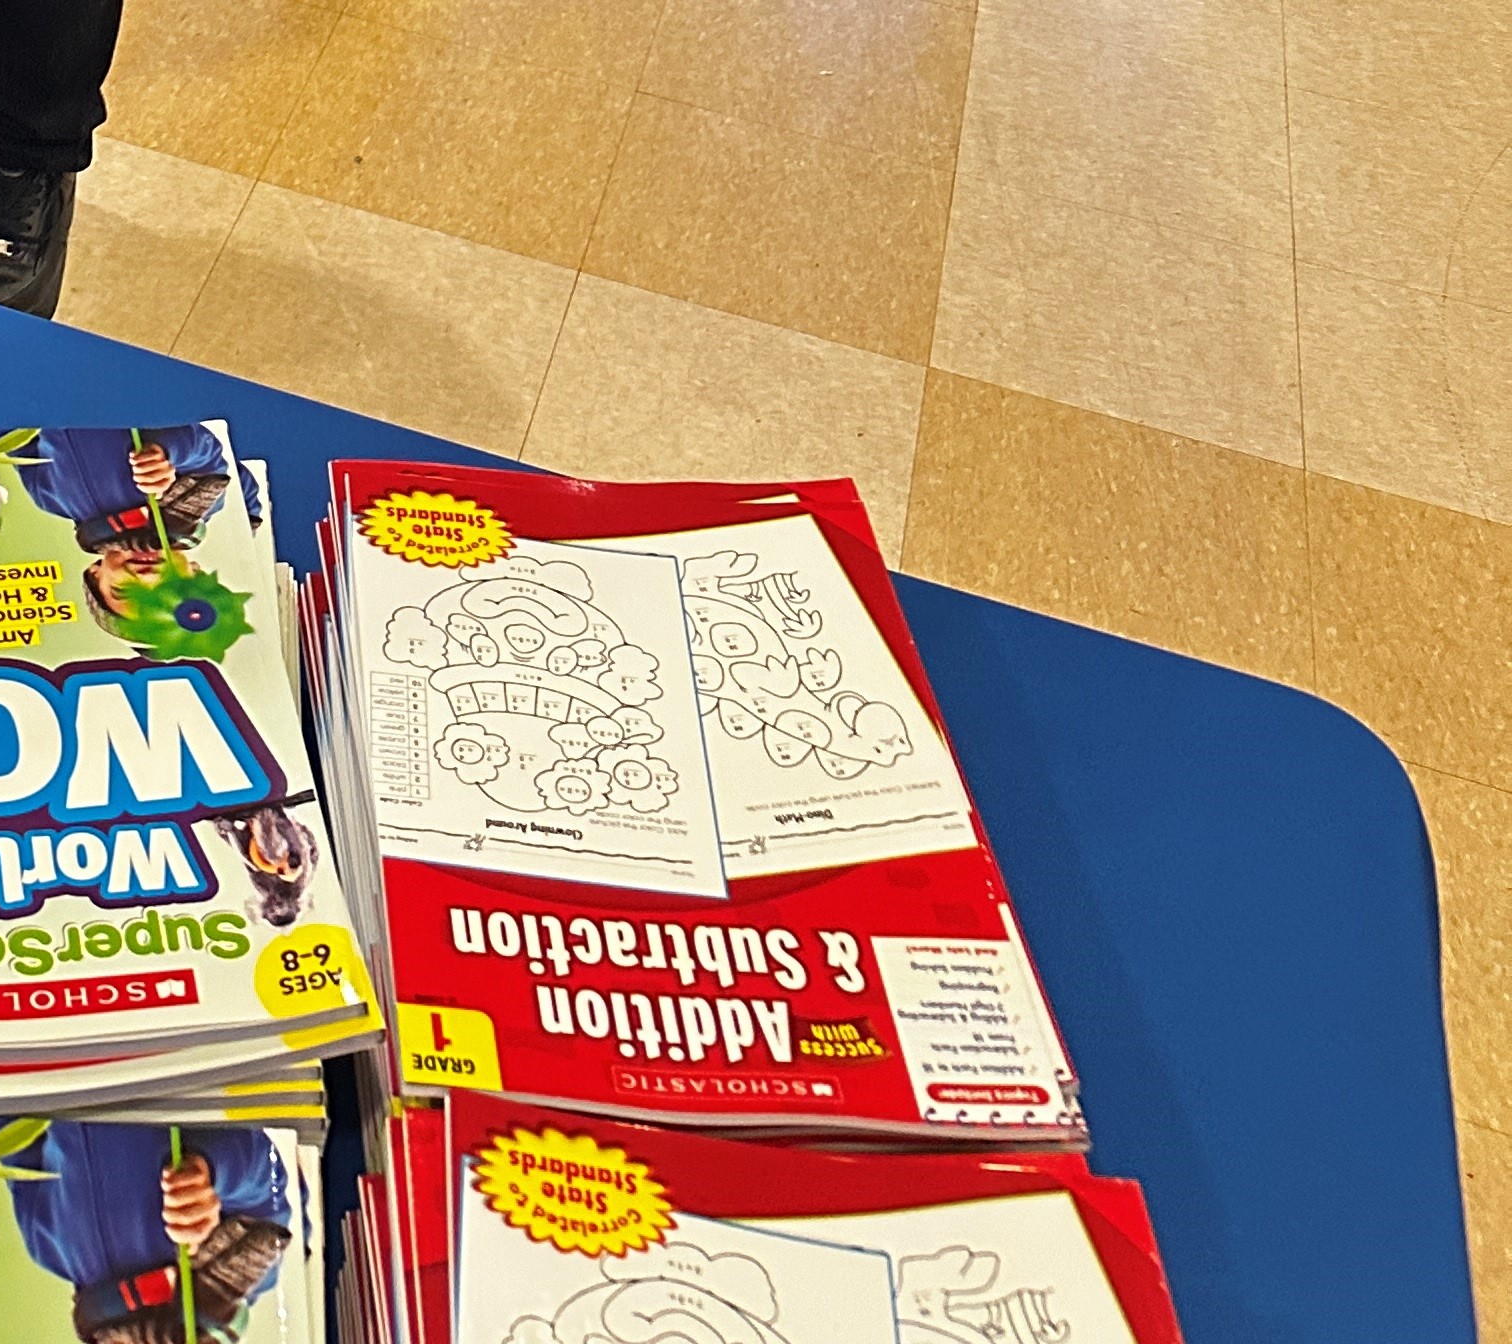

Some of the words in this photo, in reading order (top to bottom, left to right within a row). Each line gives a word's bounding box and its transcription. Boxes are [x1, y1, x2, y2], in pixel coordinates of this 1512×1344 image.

[385, 506, 486, 529] Standards
[386, 527, 403, 543] to
[411, 524, 464, 543] State
[405, 537, 490, 557] Correlated
[30, 586, 49, 603] &
[485, 818, 528, 835] Around
[530, 821, 583, 841] Clowning
[449, 907, 807, 991] Subtraction
[818, 930, 865, 993] &
[278, 966, 343, 996] AGES
[430, 1012, 452, 1053] 1
[536, 985, 793, 1063] Addition
[412, 1053, 475, 1075] GRADE
[620, 1072, 807, 1096] SCHOLASTIC
[508, 1150, 637, 1195] Standards
[508, 1183, 529, 1209] to
[541, 1182, 607, 1215] State
[531, 1204, 642, 1238] Correlated
